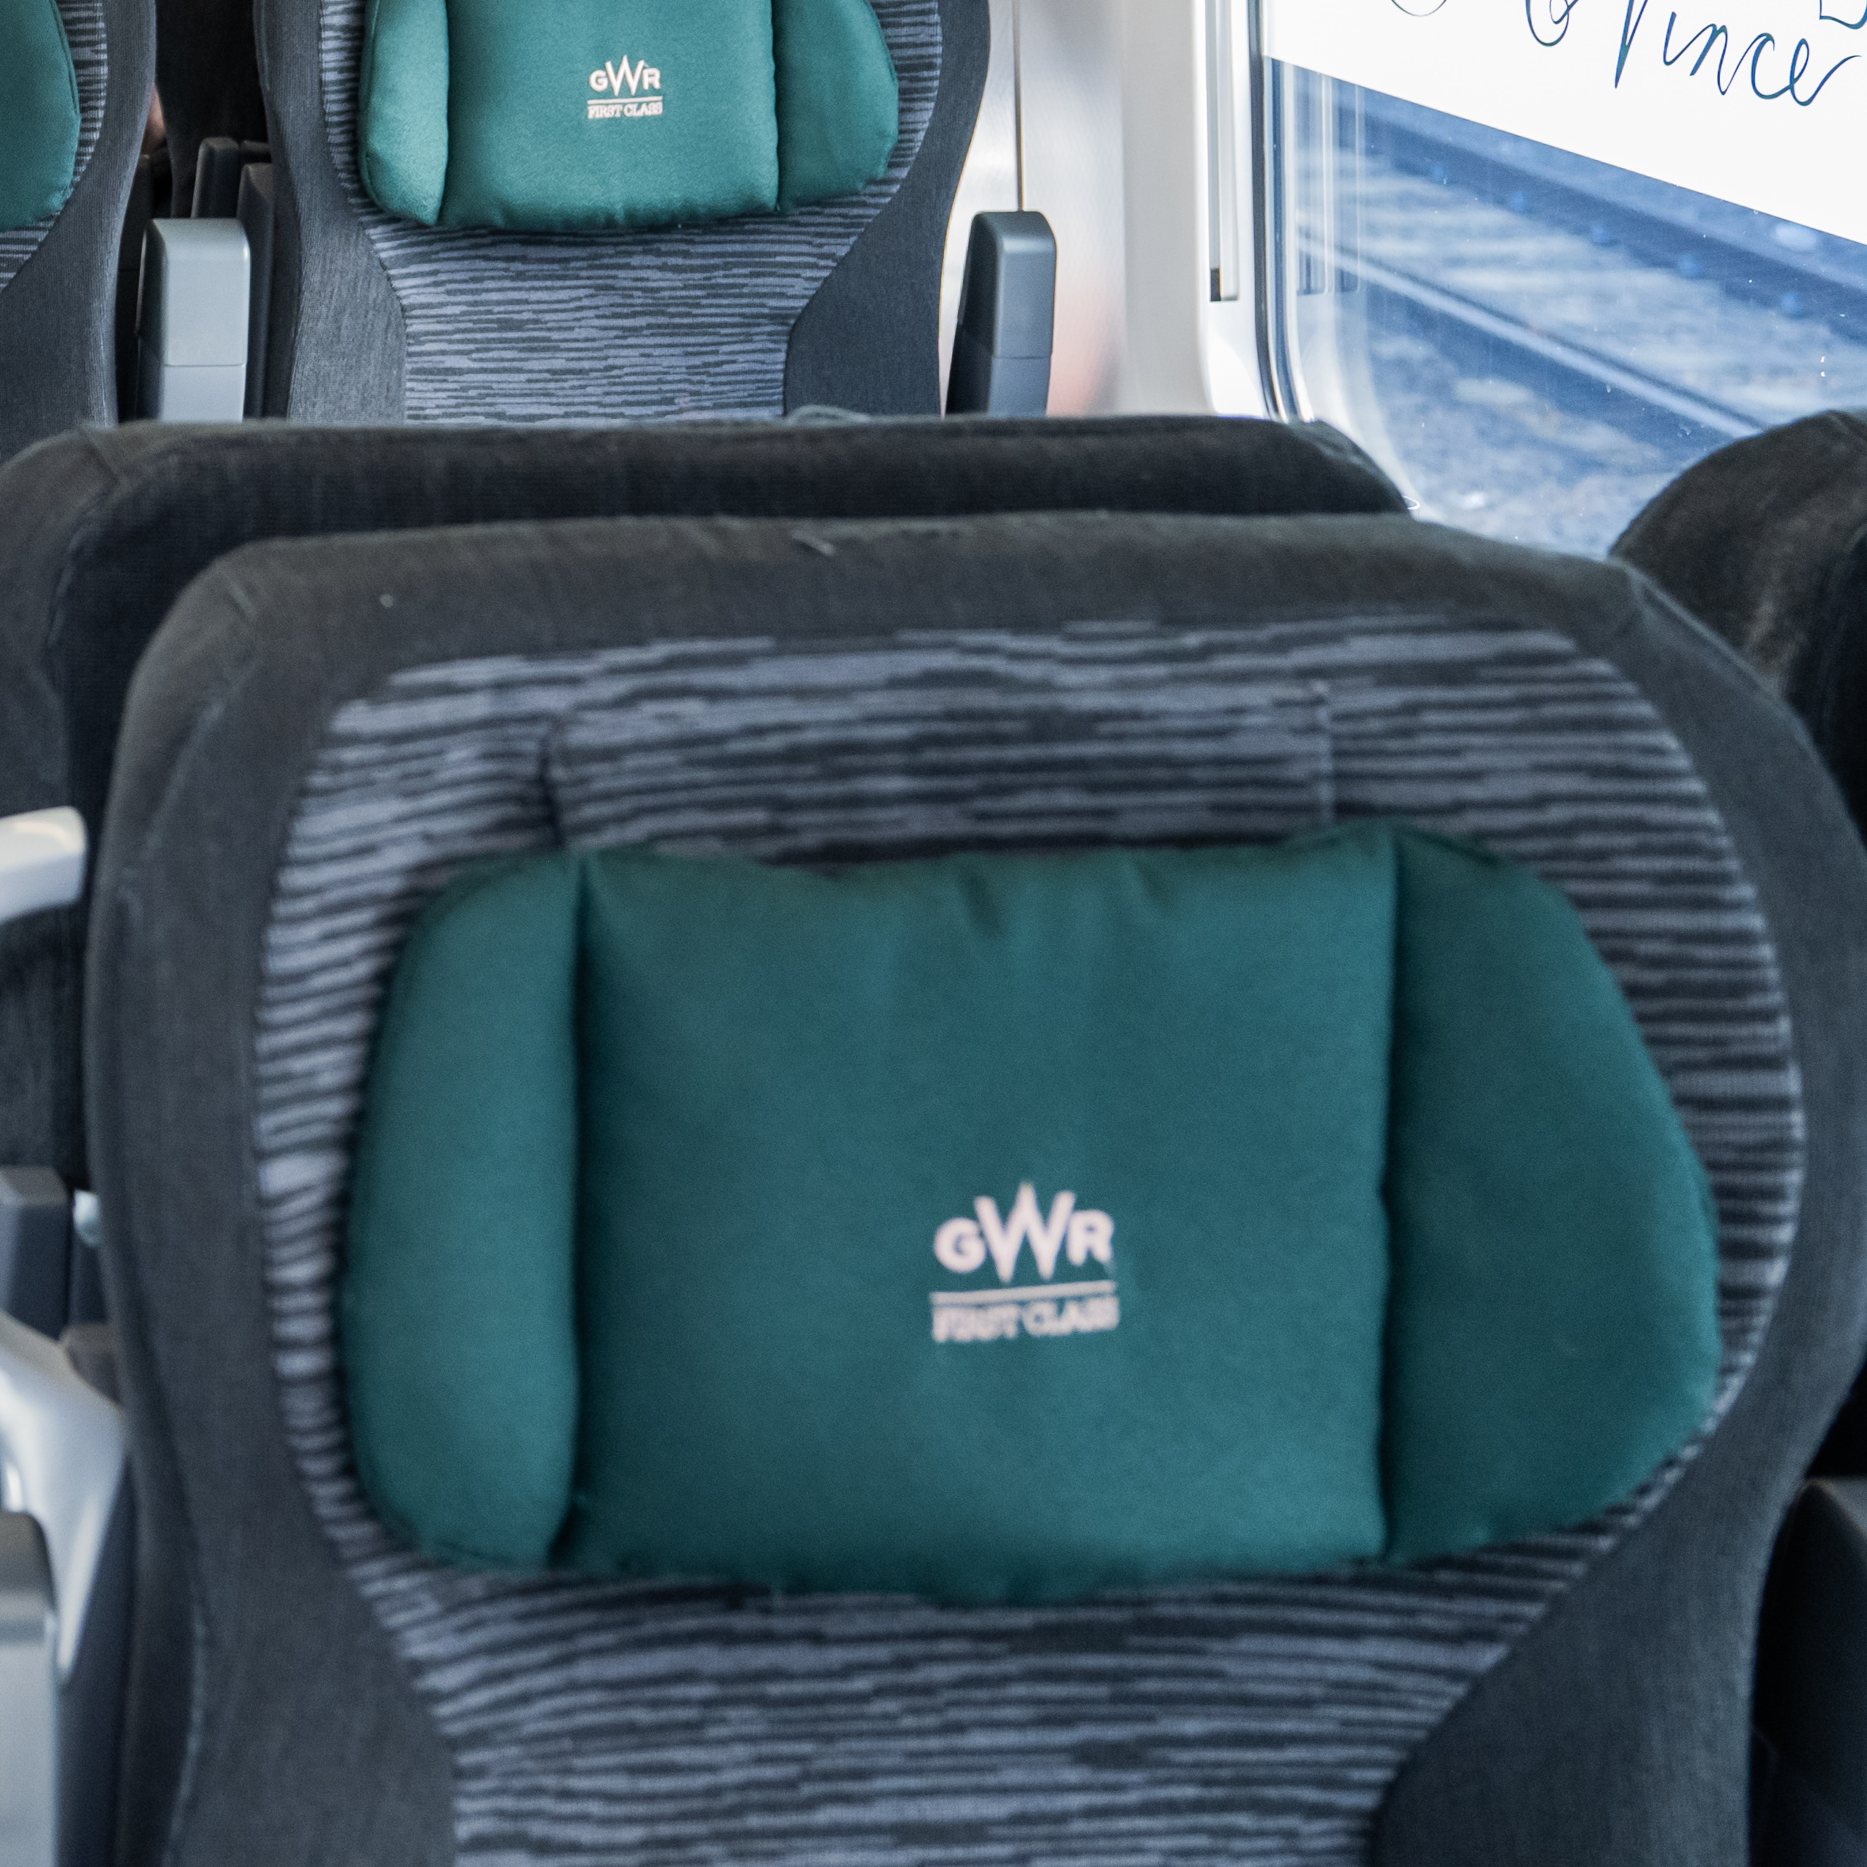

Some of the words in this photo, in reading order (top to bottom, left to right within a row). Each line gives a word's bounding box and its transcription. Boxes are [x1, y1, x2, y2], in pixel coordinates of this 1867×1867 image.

[588, 54, 661, 96] GWR
[587, 104, 623, 119] FIRST
[624, 101, 663, 117] CLASS
[933, 1180, 1115, 1283] GWR
